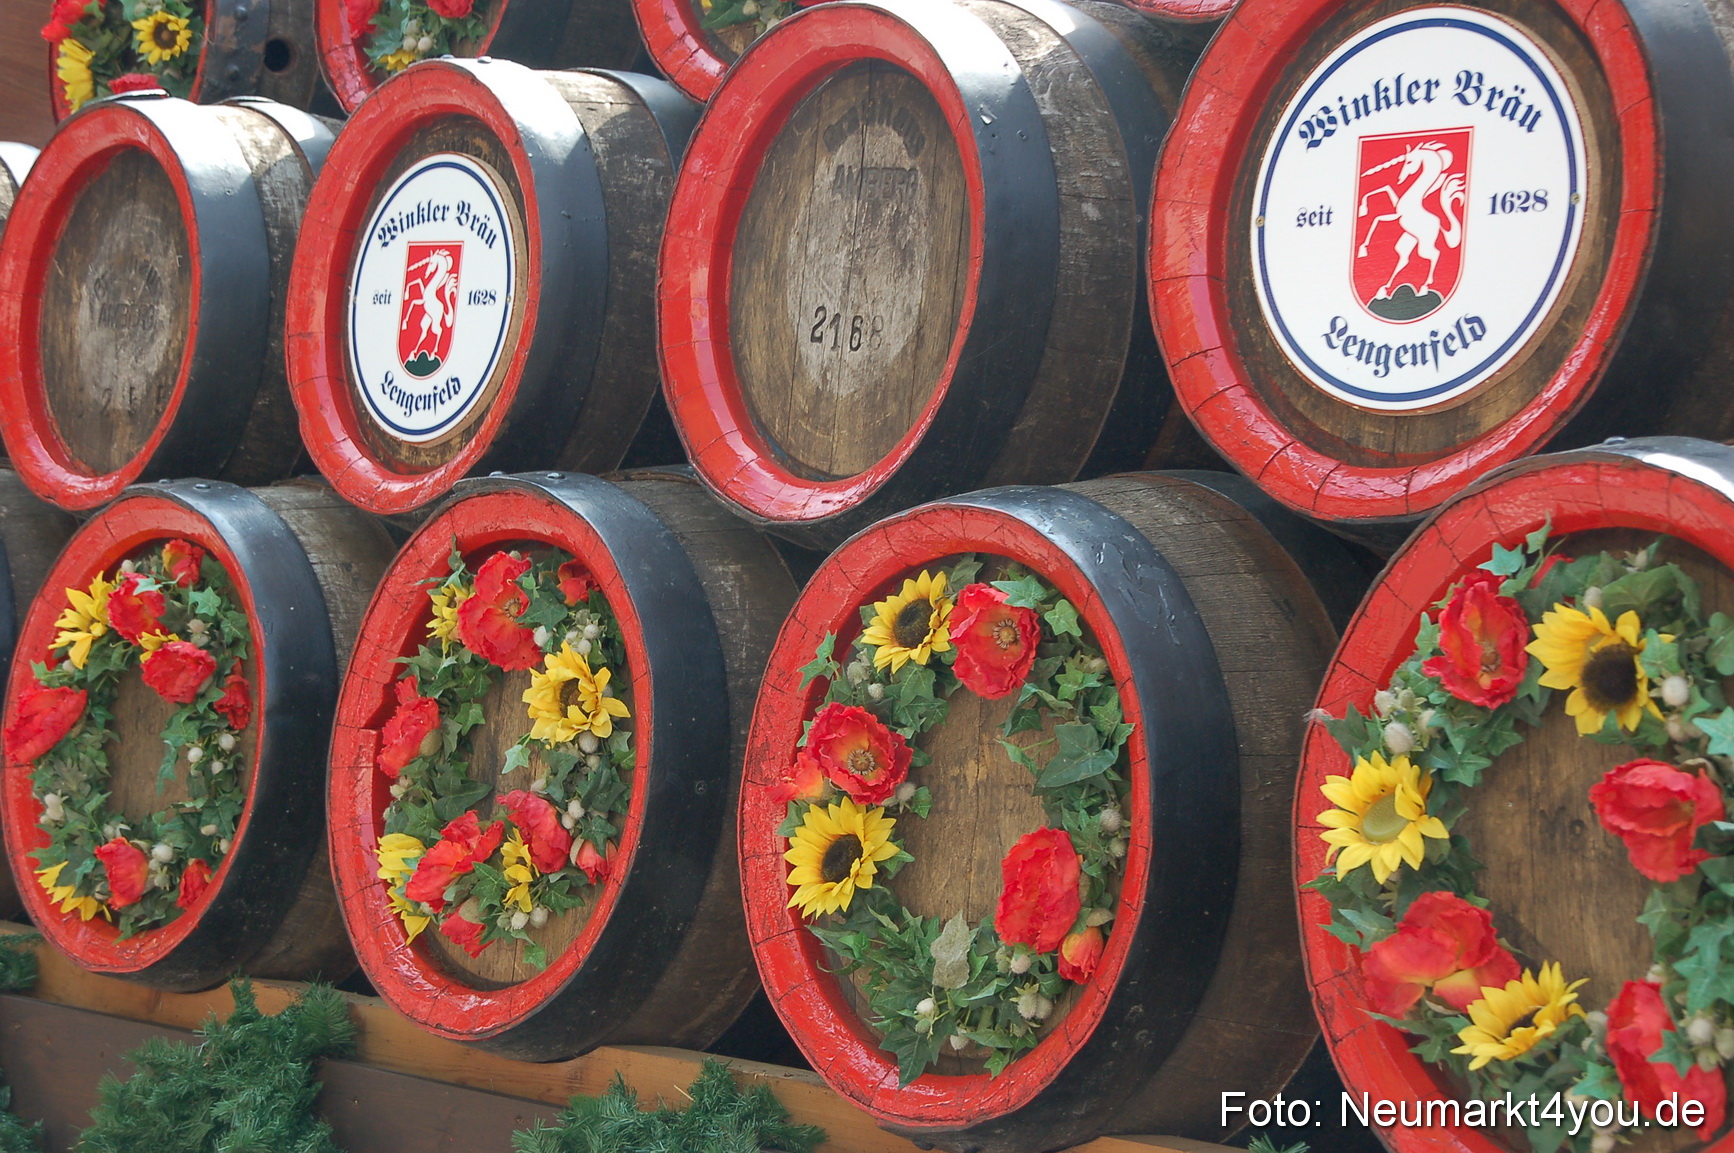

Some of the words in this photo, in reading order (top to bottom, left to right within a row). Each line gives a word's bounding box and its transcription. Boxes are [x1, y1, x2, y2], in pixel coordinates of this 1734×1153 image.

[1298, 73, 1440, 153] Winkler
[1453, 69, 1543, 133] Bräu
[377, 199, 450, 250] Winkler
[456, 200, 497, 249] Bräu
[1296, 206, 1333, 228] seit
[1487, 189, 1548, 215] 1628
[372, 289, 392, 305] seit
[467, 289, 497, 306] 1628
[810, 305, 884, 352] 2168
[1321, 313, 1487, 378] Lengenfeld
[380, 370, 462, 418] Lengenfeld
